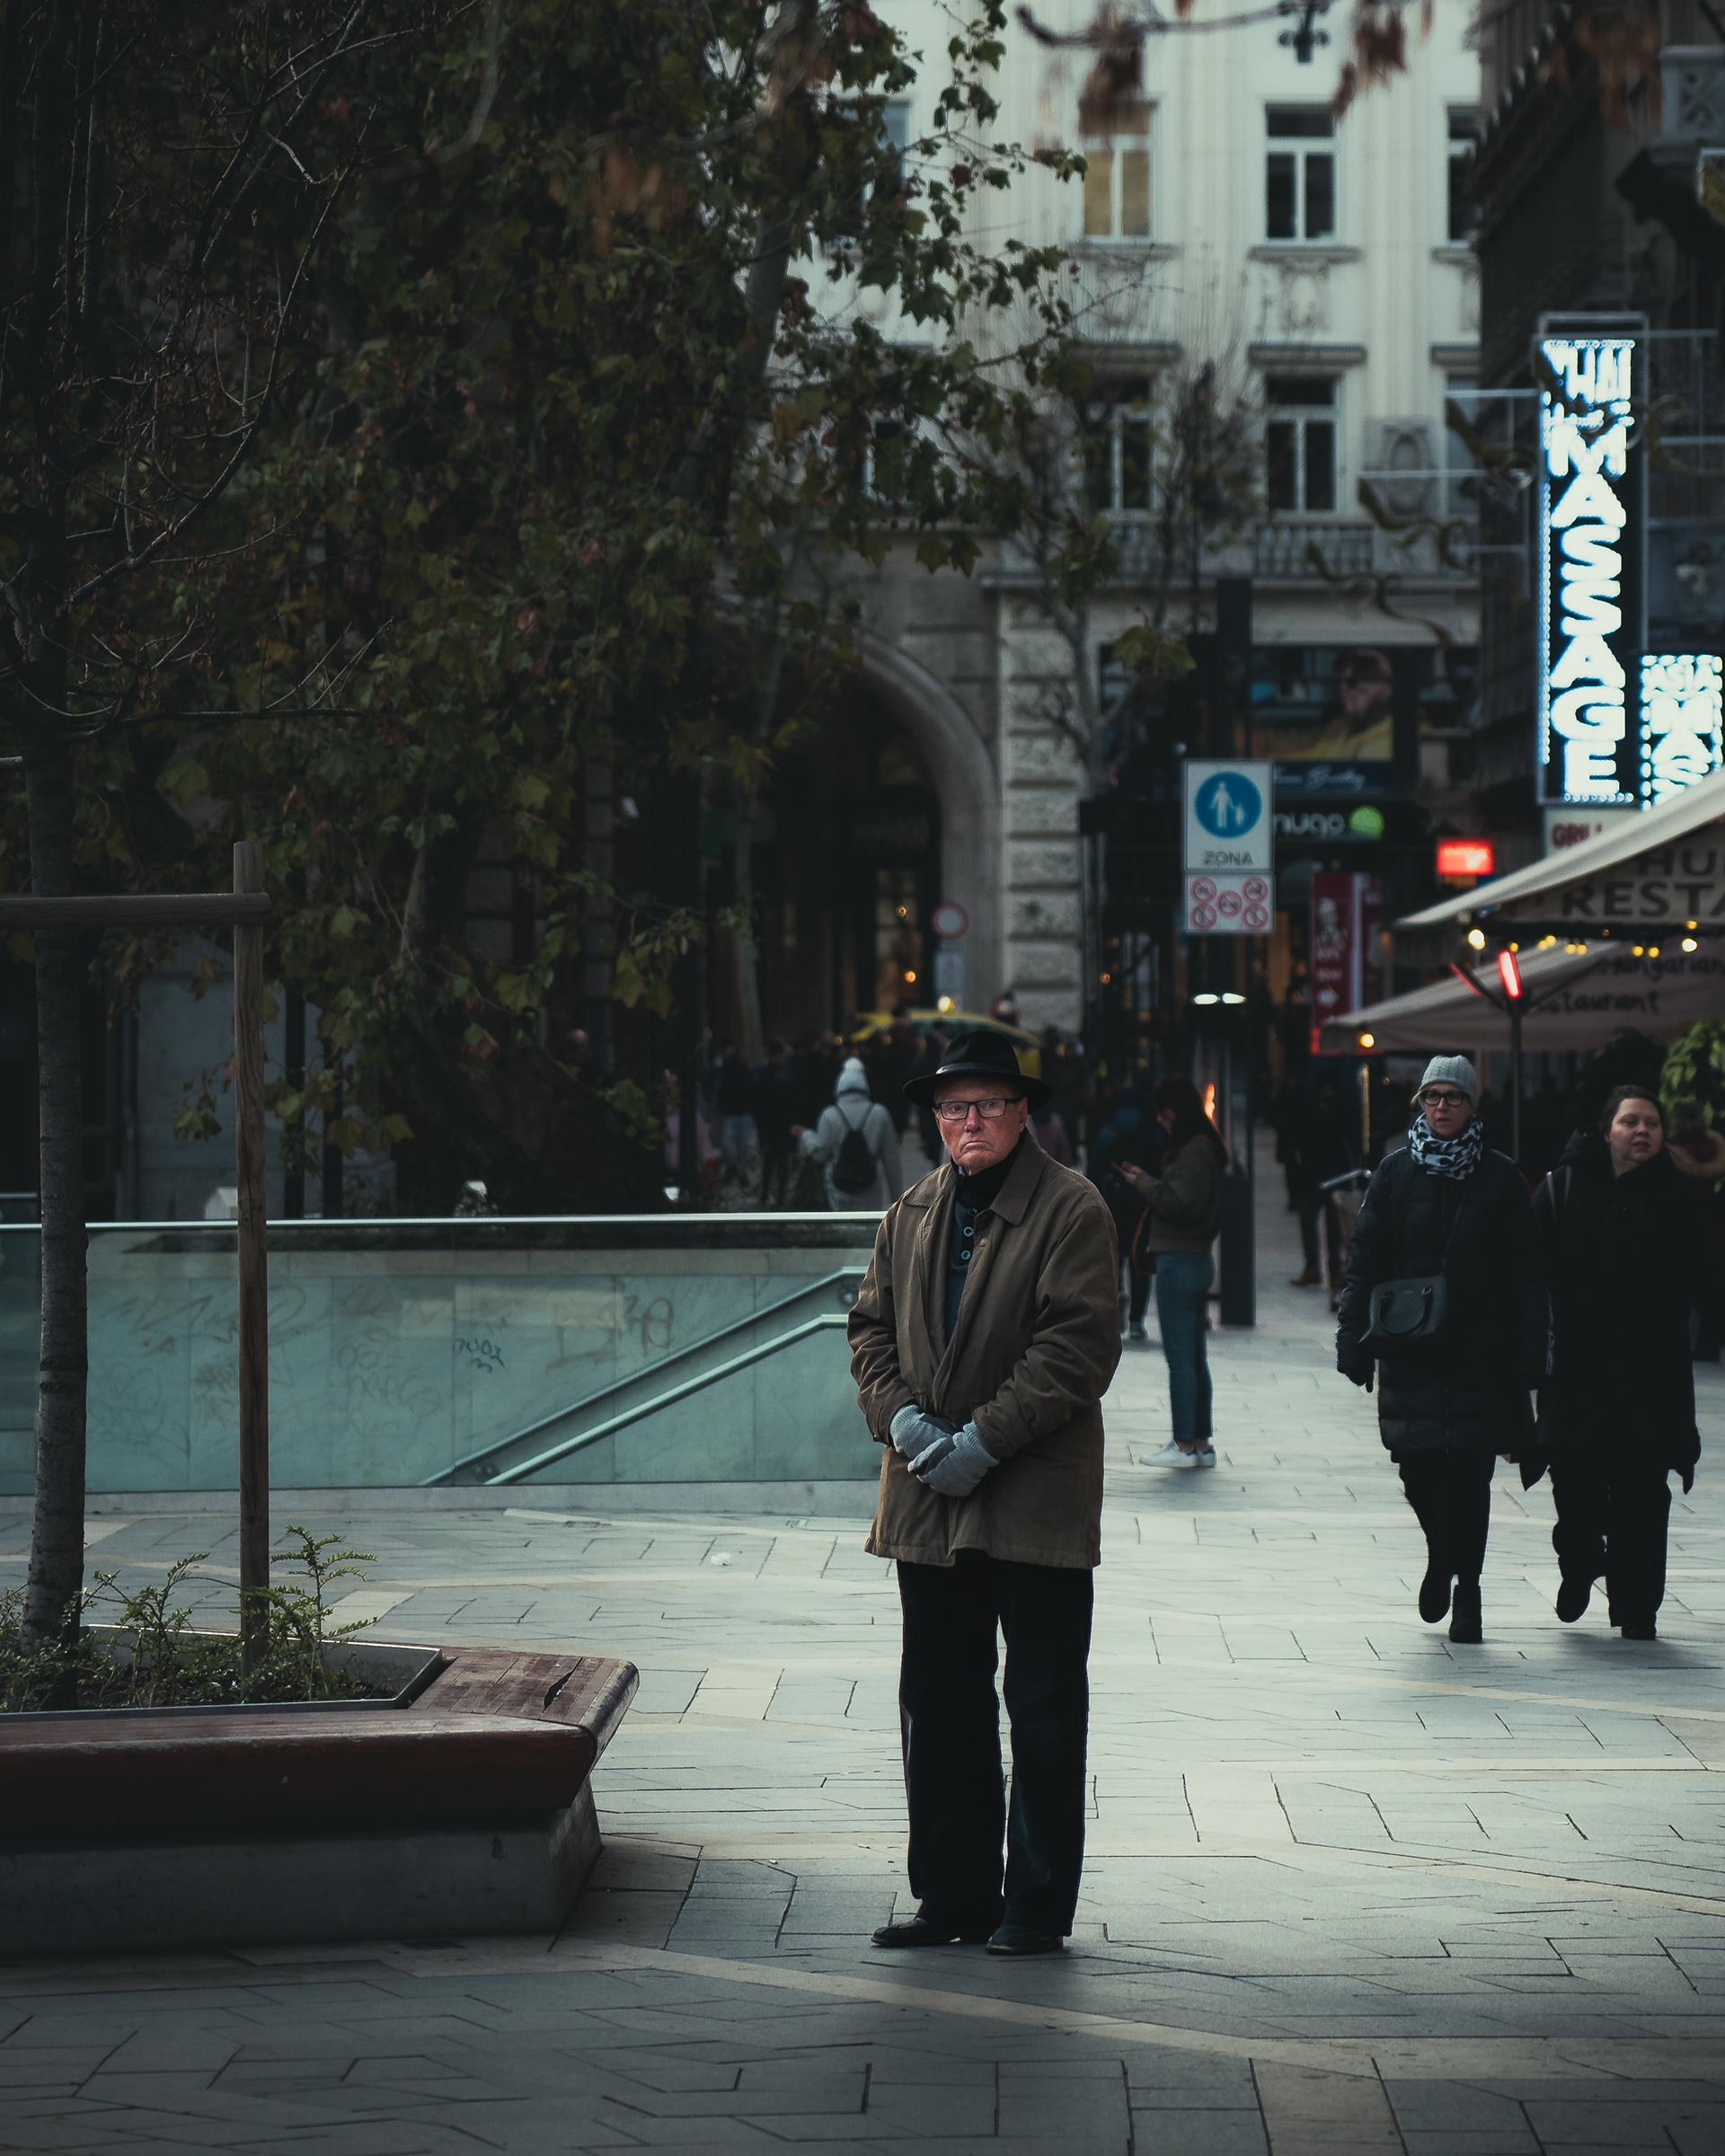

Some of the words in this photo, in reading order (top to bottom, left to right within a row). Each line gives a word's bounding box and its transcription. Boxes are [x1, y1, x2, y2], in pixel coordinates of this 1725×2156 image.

[1549, 422, 1627, 795] MASSAGE
[1649, 663, 1714, 694] ASIA
[1639, 850, 1725, 877] HU
